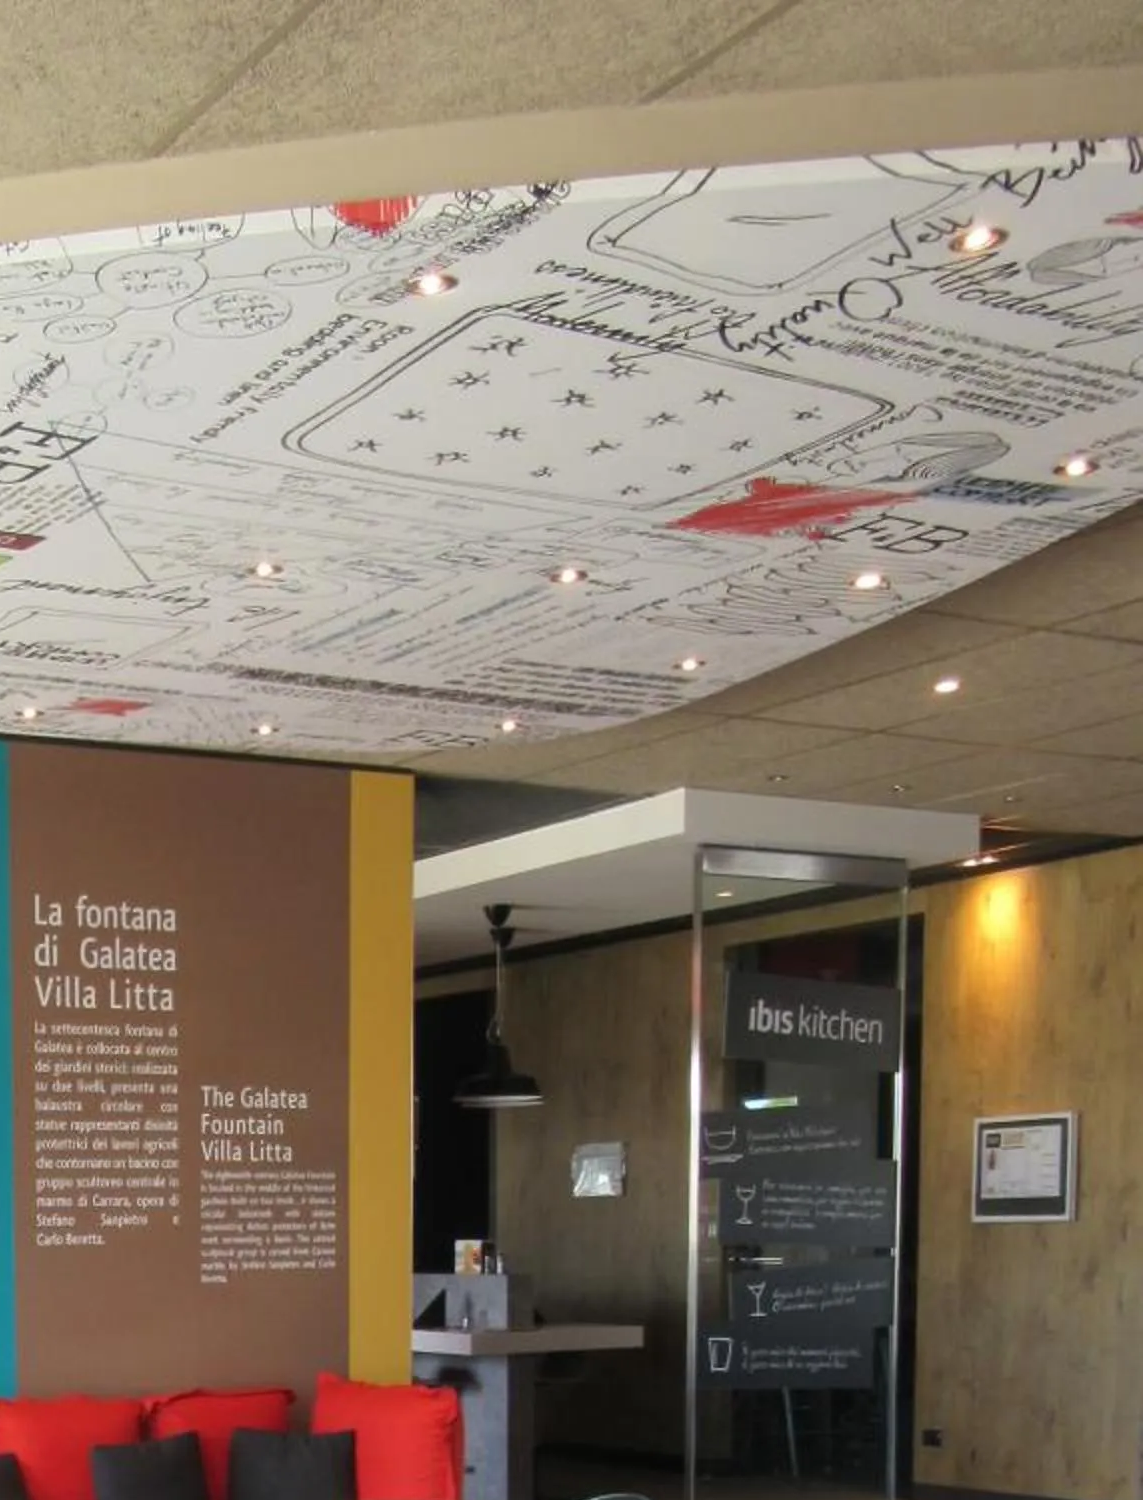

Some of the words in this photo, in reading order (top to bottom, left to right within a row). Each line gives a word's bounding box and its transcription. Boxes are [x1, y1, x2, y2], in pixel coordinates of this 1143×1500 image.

[34, 894, 62, 927] La
[75, 895, 177, 931] fontana
[34, 935, 59, 967] di
[80, 937, 177, 971] Galatea
[35, 976, 97, 1009] Villa
[110, 978, 175, 1011] Litta
[748, 998, 795, 1035] ibis
[798, 1001, 884, 1044] kitchen
[201, 1086, 235, 1109] The
[240, 1088, 308, 1110] Galatea
[201, 1114, 285, 1136] Fountain
[201, 1141, 242, 1162] Villa
[250, 1142, 293, 1162] Litta
